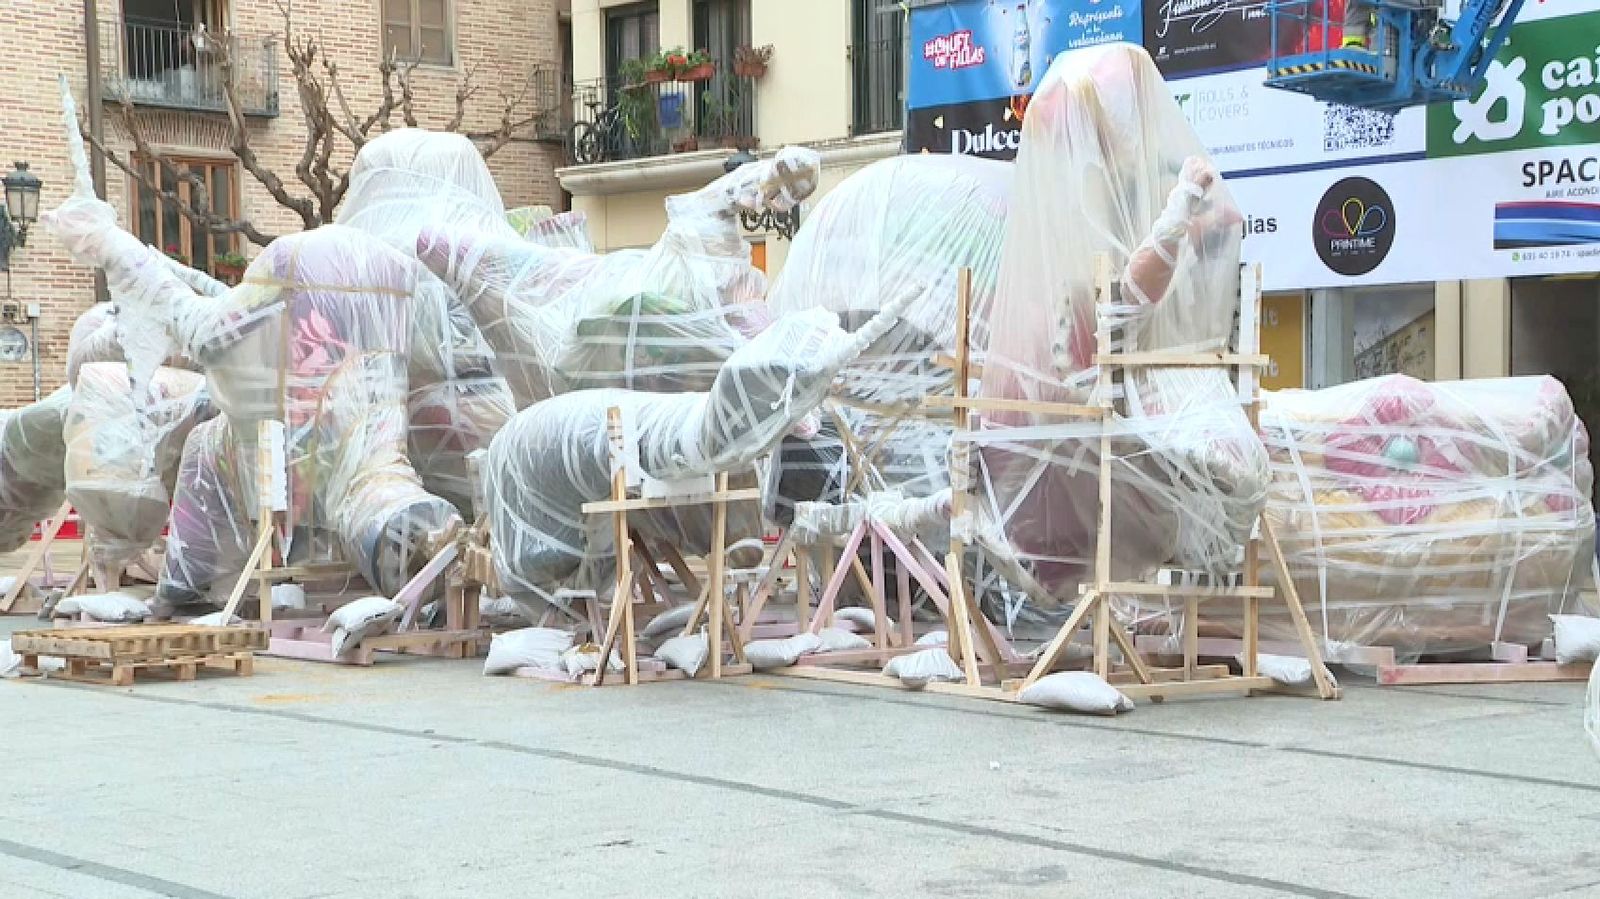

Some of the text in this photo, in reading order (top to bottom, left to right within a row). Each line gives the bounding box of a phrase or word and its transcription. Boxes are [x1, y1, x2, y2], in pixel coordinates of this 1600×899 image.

[1199, 87, 1234, 104] ROLLS
[1199, 102, 1249, 121] COVERS
[1539, 93, 1600, 135] po
[1522, 156, 1600, 187] SPAC
